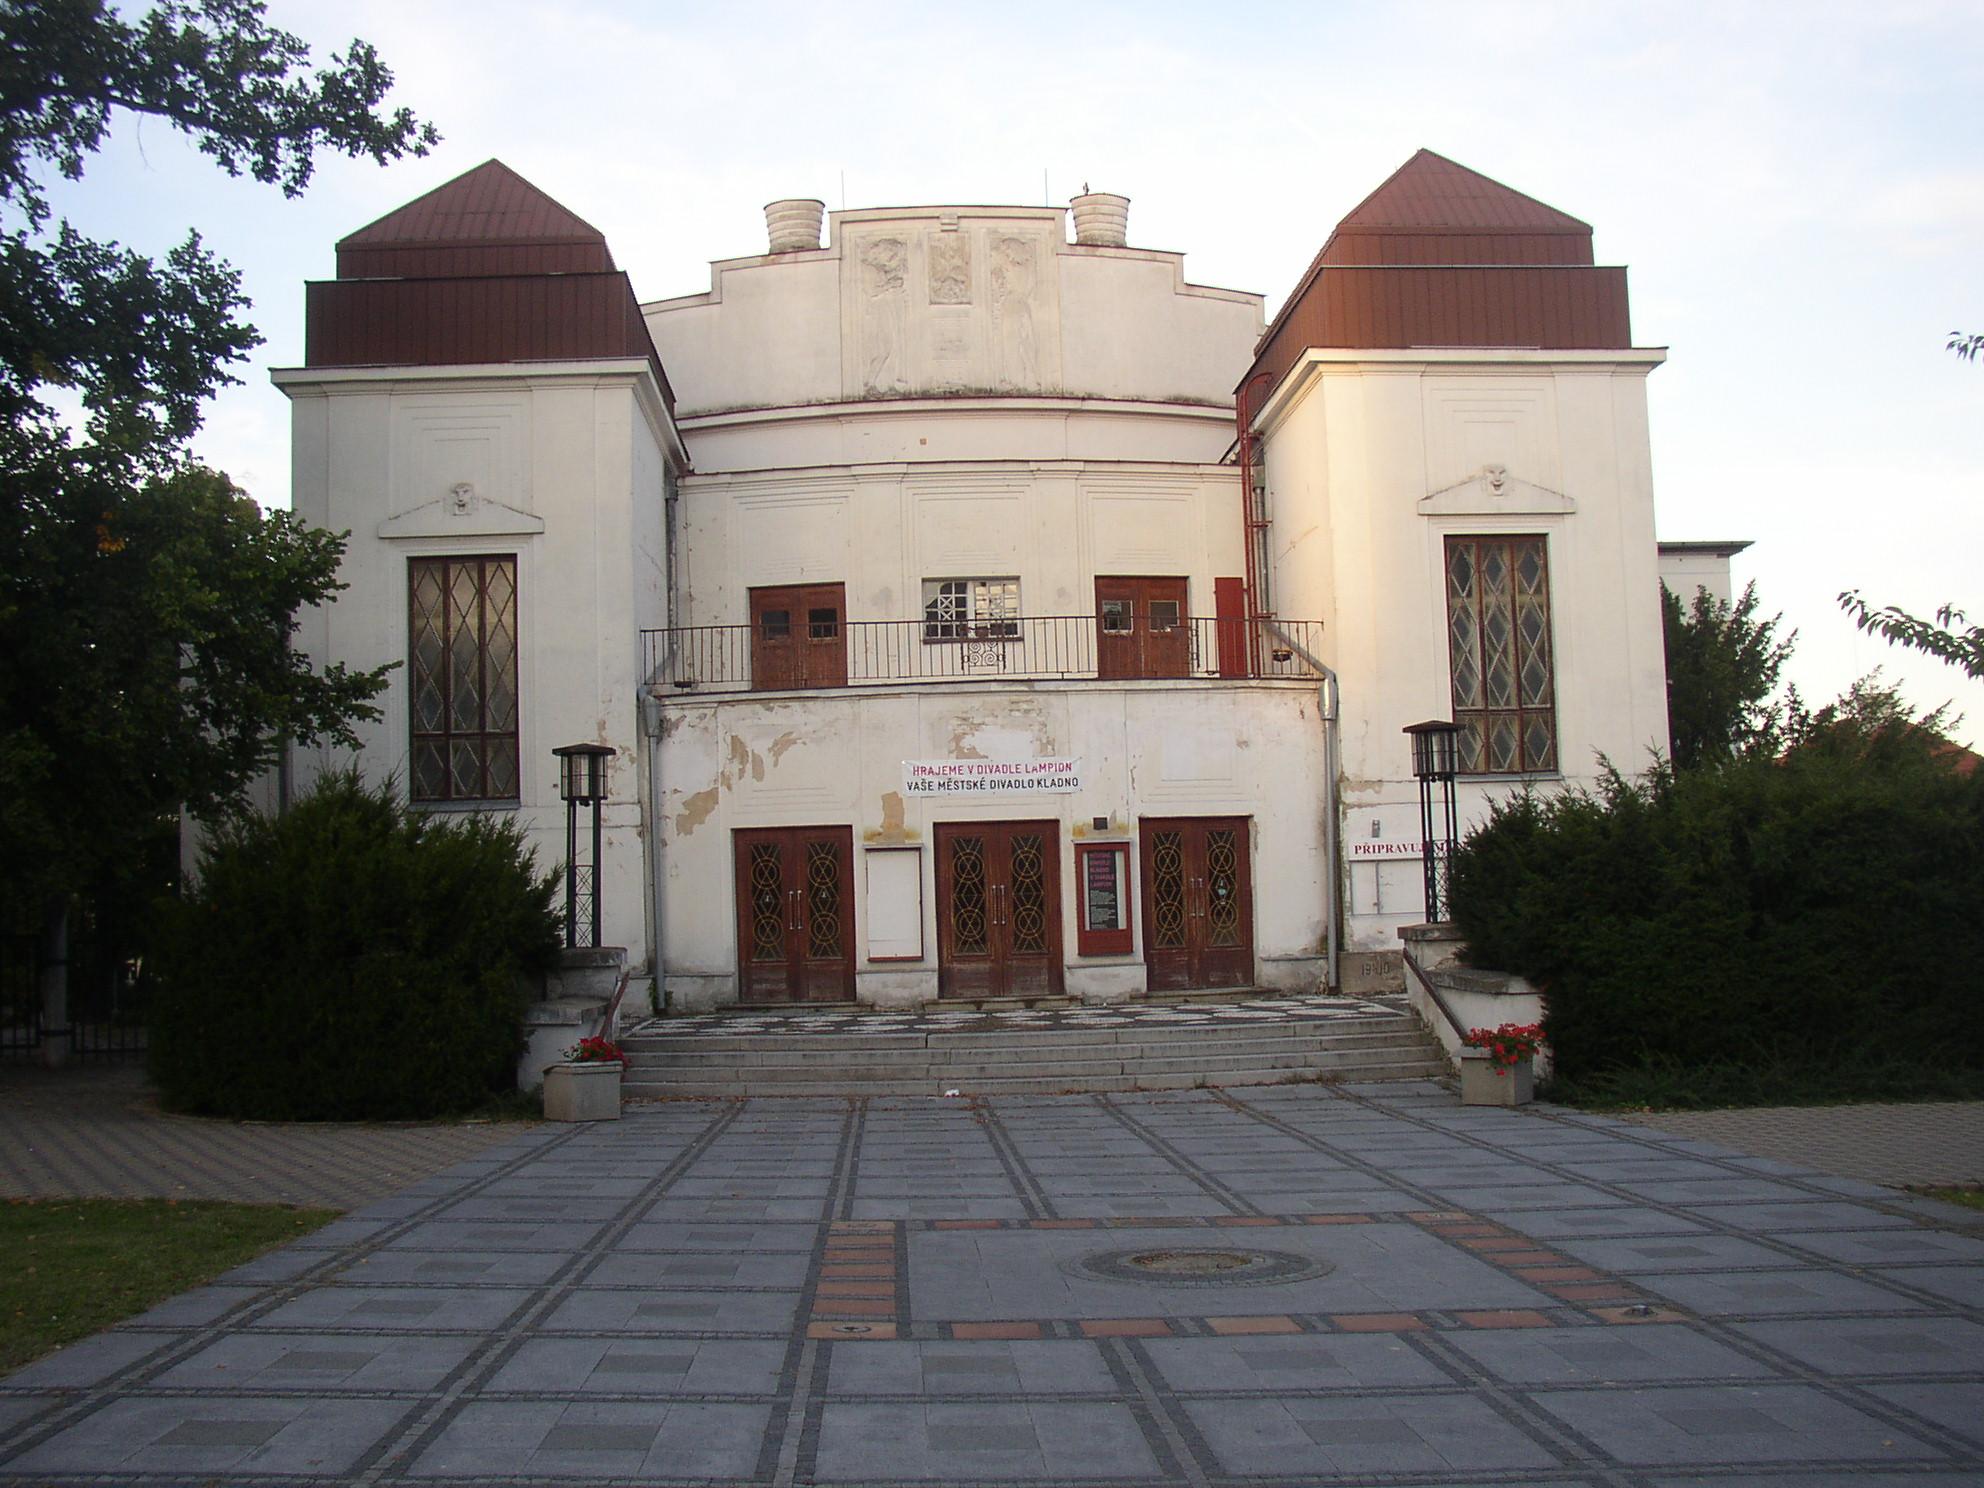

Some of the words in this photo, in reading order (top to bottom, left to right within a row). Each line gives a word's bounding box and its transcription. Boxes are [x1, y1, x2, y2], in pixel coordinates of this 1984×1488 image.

[912, 764, 964, 776] HRAJEME
[967, 764, 974, 775] V
[977, 763, 1021, 775] DIVADLE
[1024, 762, 1073, 774] LAMPION
[907, 778, 934, 791] VAŠE
[937, 776, 986, 791] MĚSTSKÉ
[989, 778, 1033, 790] DIVADLO
[1036, 777, 1079, 789] KLADNO
